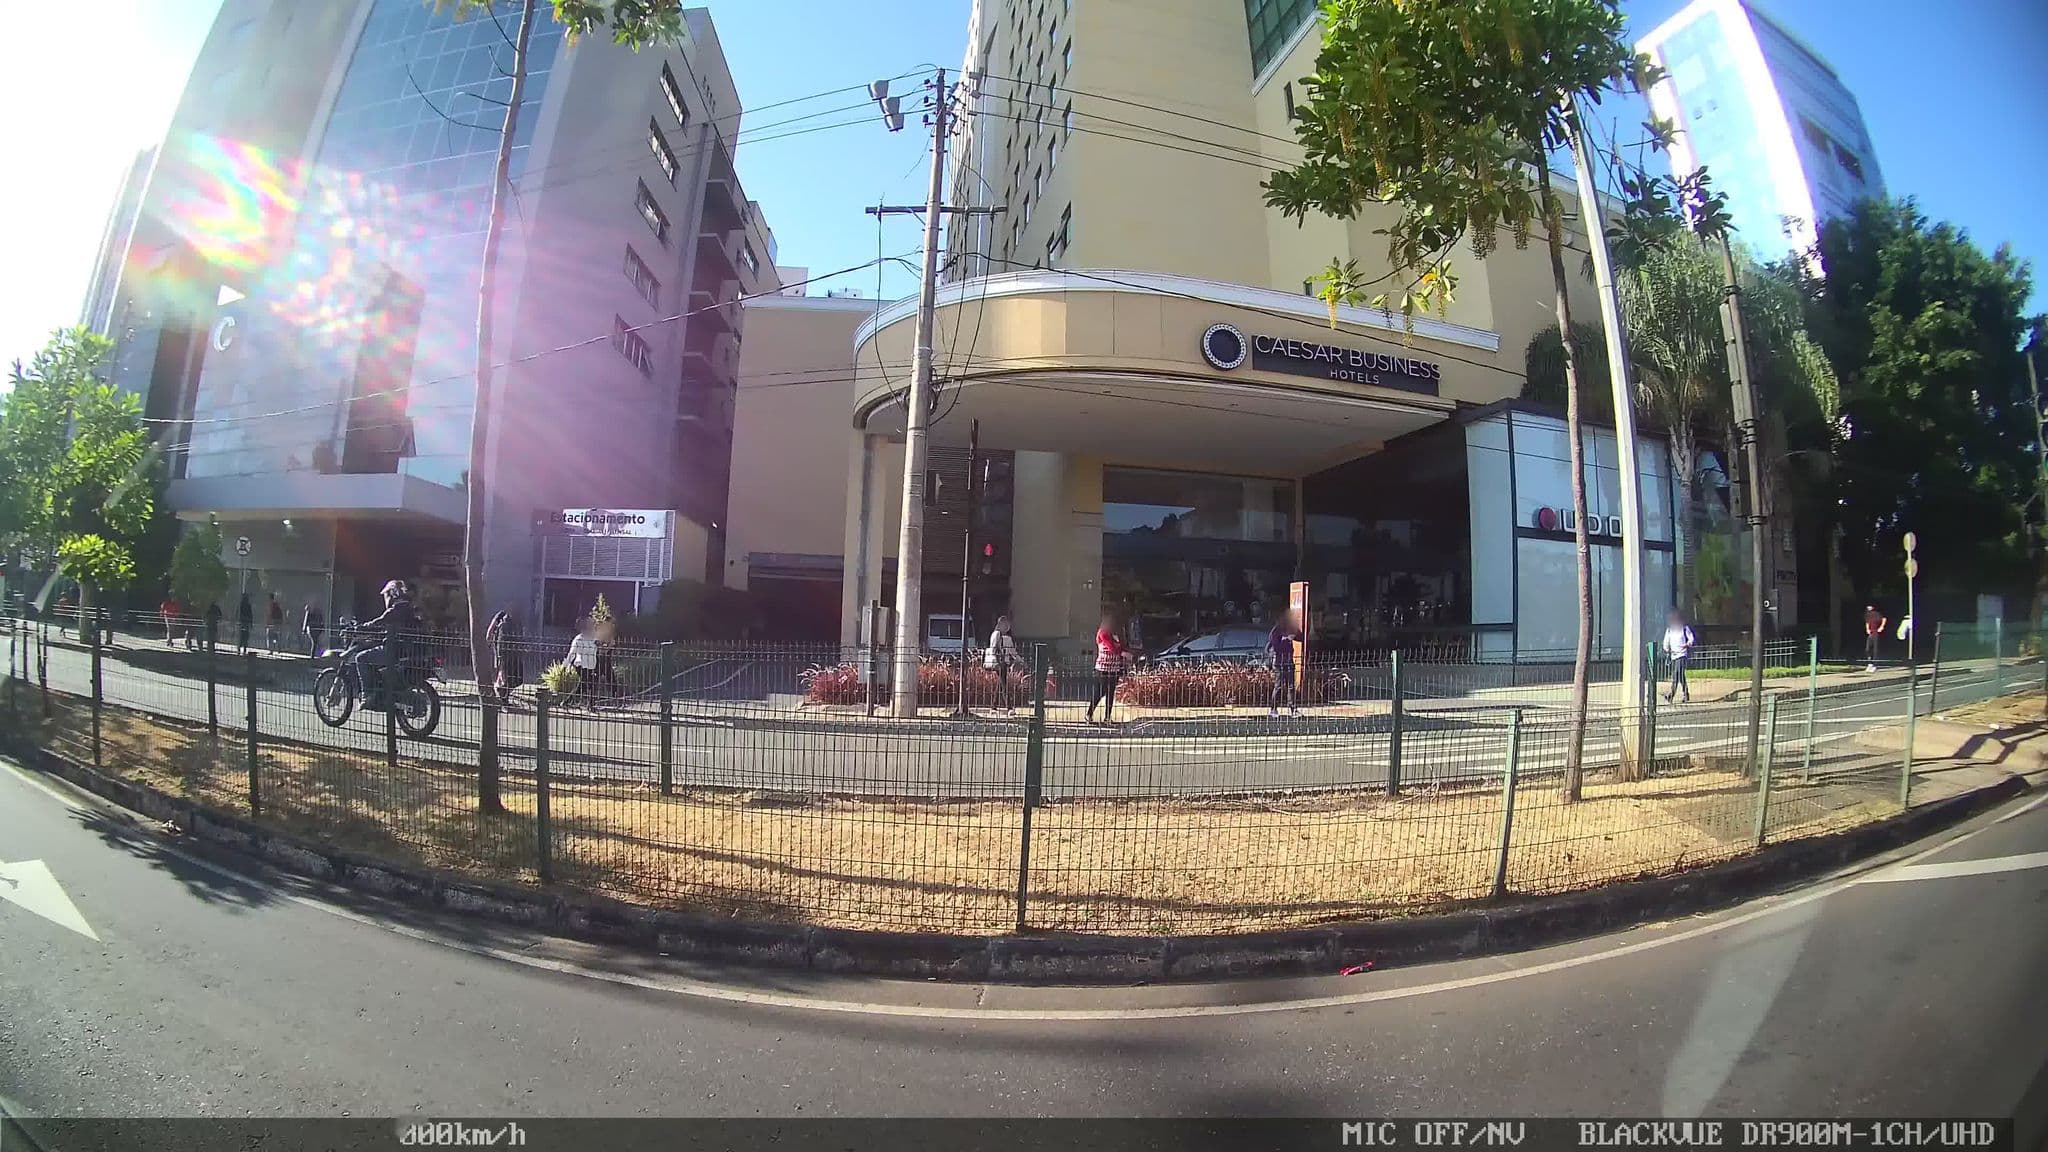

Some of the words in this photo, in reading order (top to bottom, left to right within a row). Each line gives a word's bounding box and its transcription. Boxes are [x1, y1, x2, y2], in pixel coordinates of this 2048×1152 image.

[1255, 334, 1343, 364] CAESAR
[1349, 350, 1442, 380] BUSINESS
[1330, 370, 1380, 385] HOTELS
